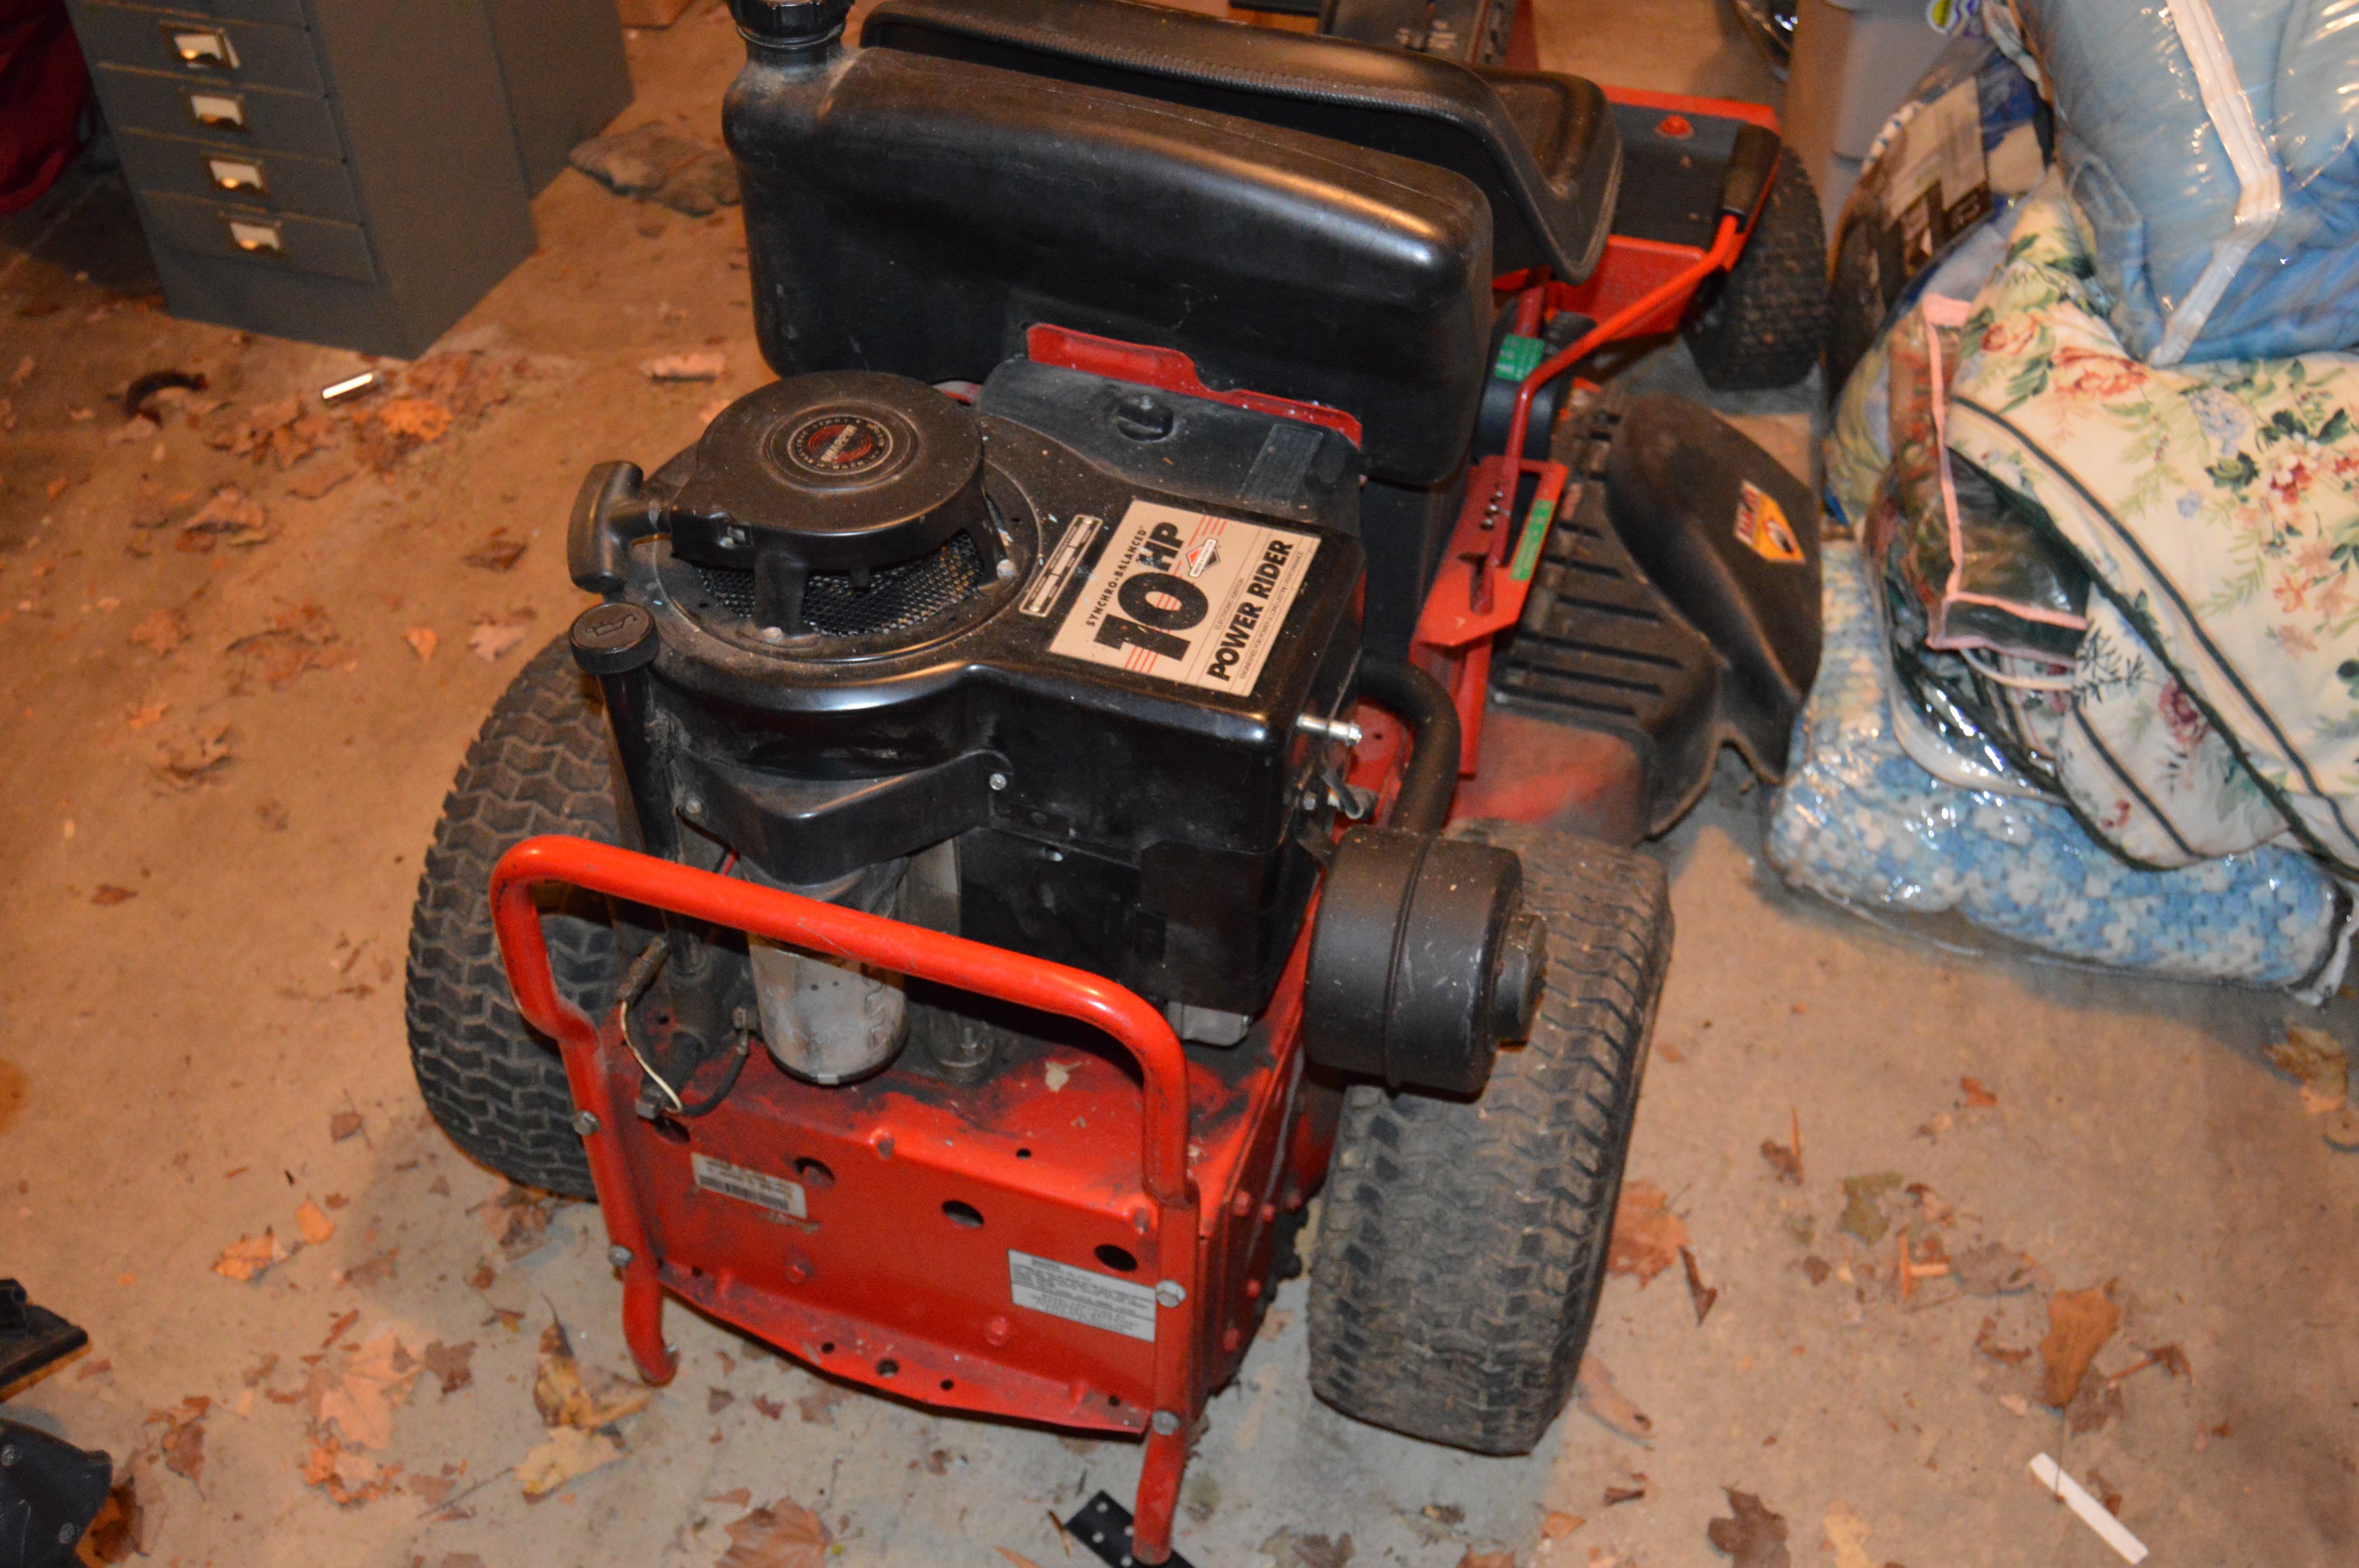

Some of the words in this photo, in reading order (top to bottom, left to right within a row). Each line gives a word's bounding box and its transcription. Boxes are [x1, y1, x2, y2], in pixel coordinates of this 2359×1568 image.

[1136, 522, 1183, 571] HP
[1094, 572, 1208, 661] 10
[1207, 602, 1263, 681] POWER
[1247, 540, 1292, 598] RIDER
[1215, 601, 1233, 629] ELECTRONIC
[1239, 649, 1257, 678] ENGINEERED
[1258, 620, 1269, 638] POWER
[1270, 603, 1280, 616] LONG
